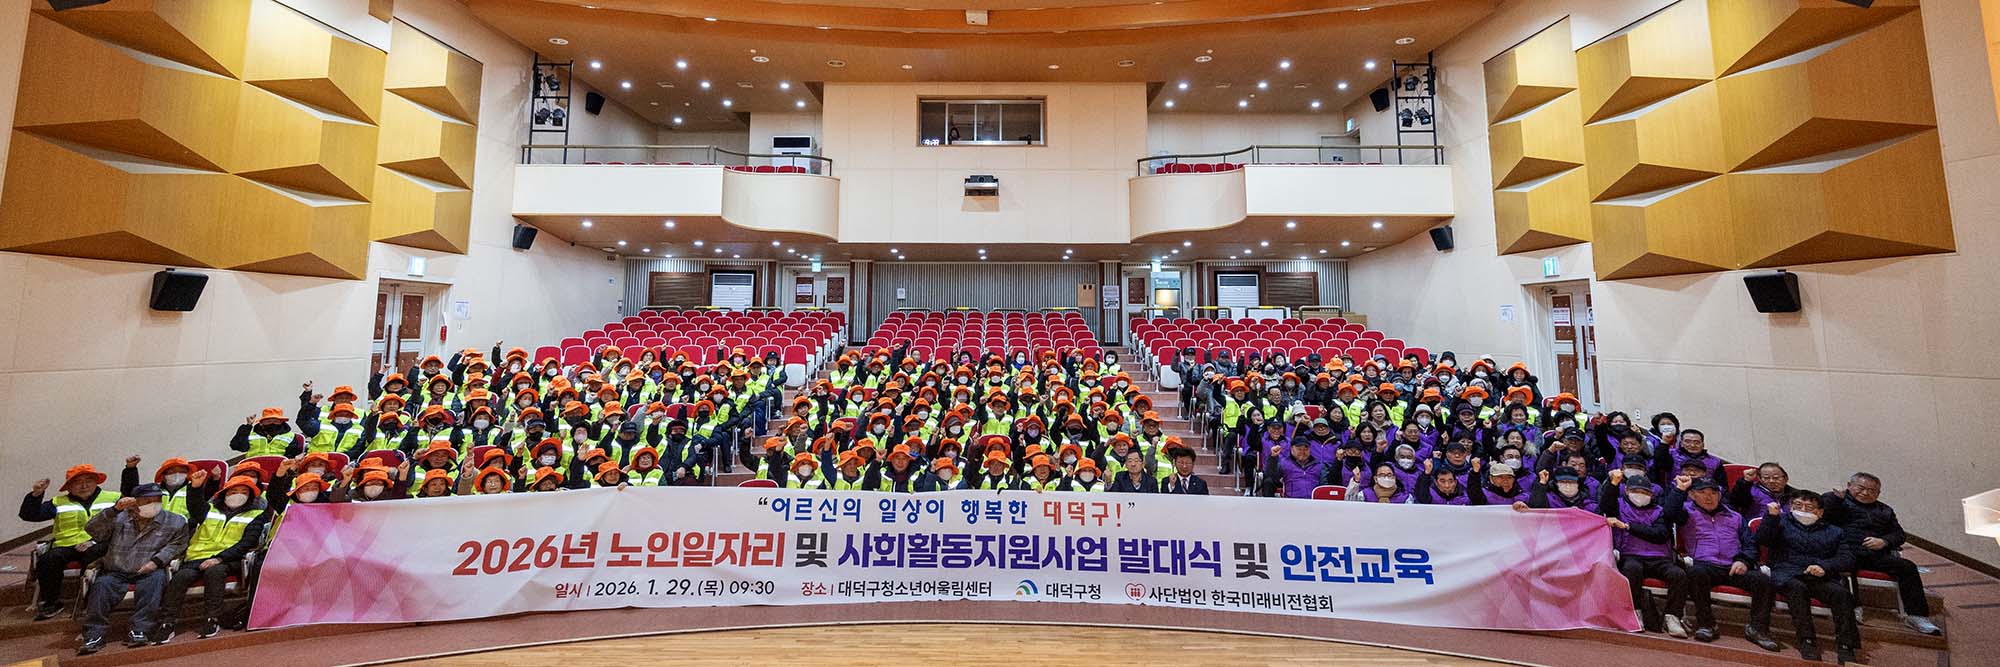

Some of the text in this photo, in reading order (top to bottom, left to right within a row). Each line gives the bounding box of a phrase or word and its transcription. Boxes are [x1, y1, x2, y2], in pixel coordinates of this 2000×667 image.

[758, 497, 1136, 527] “어르신의 일상이 행복한 대덕구!”
[452, 532, 1435, 586] 2026년 노인일자리 및 사회활동지원사업 발대식 및 안전교육
[554, 583, 582, 598] 일시
[594, 581, 640, 597] 2026.
[648, 579, 659, 595] 1.
[729, 580, 775, 595] 09:30
[802, 580, 992, 598] 장소 대덕구청소년어울림센터
[1046, 583, 1102, 600] 대덕구청
[1149, 586, 1334, 613] 사단법인 한국미래비전협회
